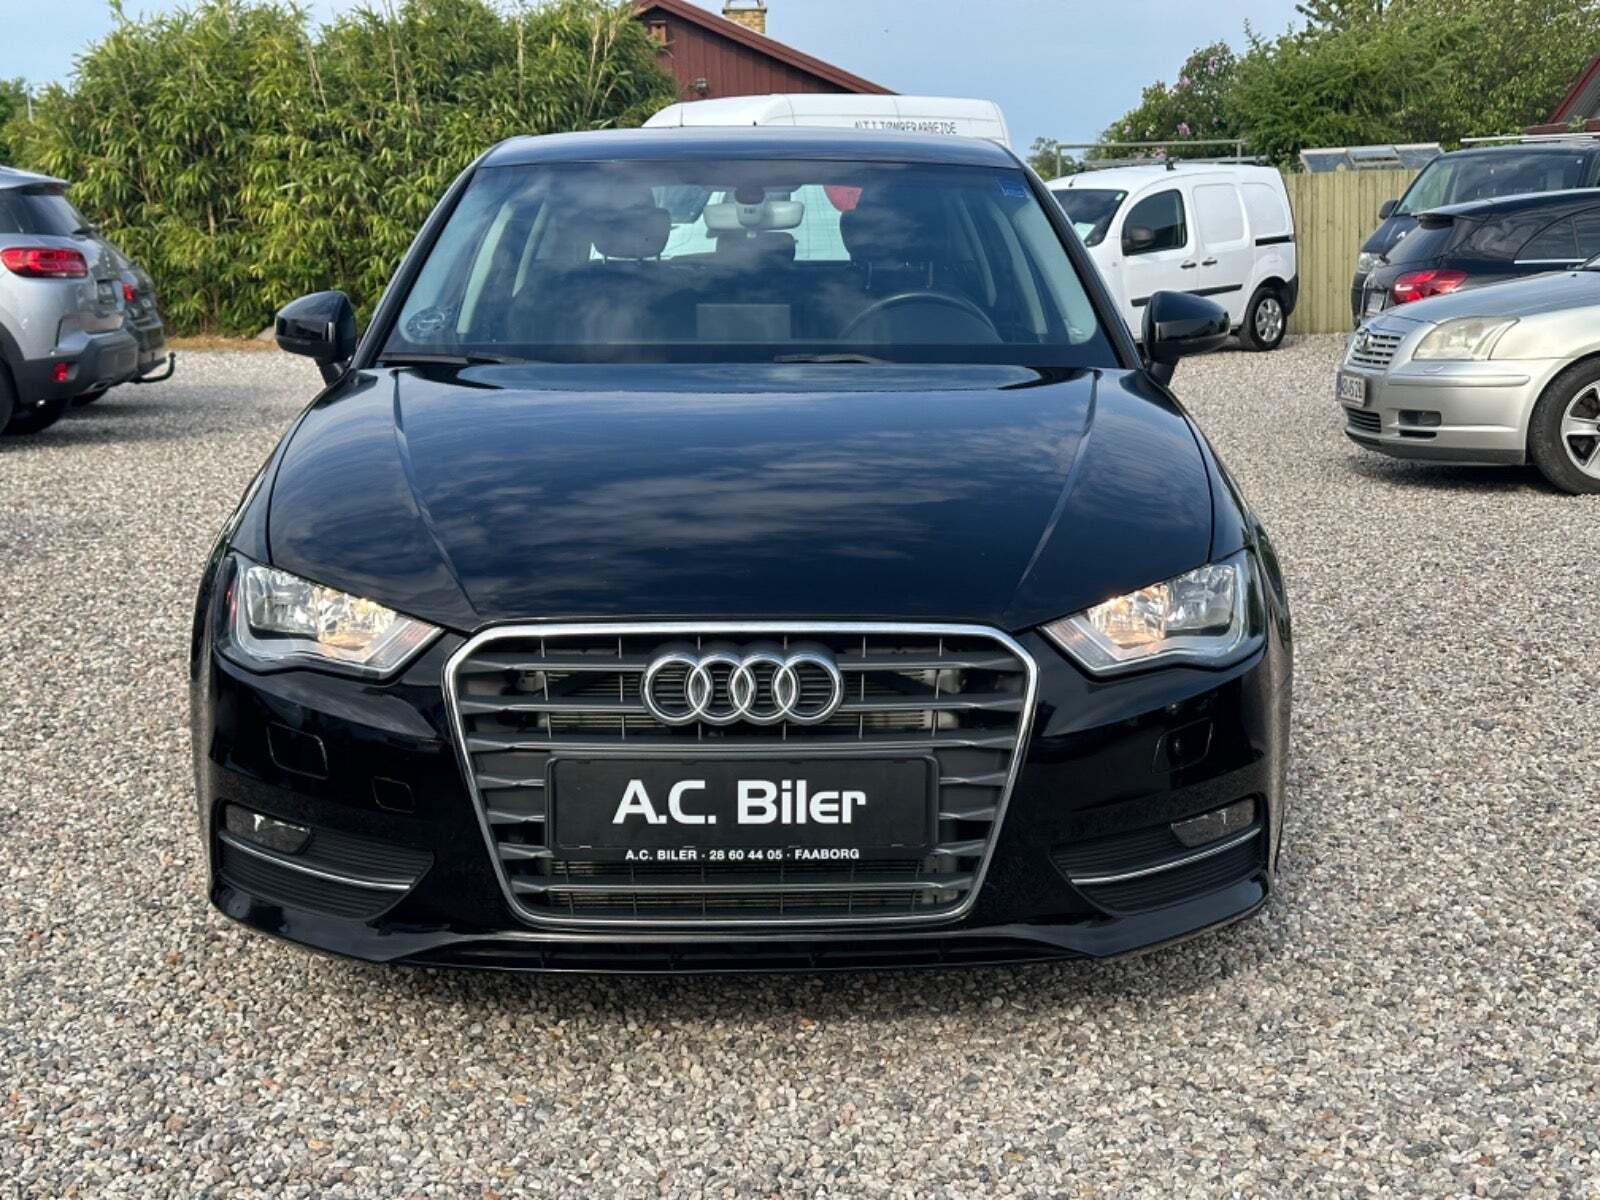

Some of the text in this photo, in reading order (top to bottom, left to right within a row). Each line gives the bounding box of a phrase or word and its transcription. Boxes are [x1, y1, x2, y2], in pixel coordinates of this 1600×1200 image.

[613, 780, 866, 824] A.C. Biler
[625, 850, 652, 860] A.C.
[657, 850, 697, 860] BILER
[710, 850, 725, 860] 28
[729, 850, 744, 860] 60
[748, 850, 763, 859] 44
[767, 850, 783, 859] 05
[795, 849, 859, 859] FAABORG
